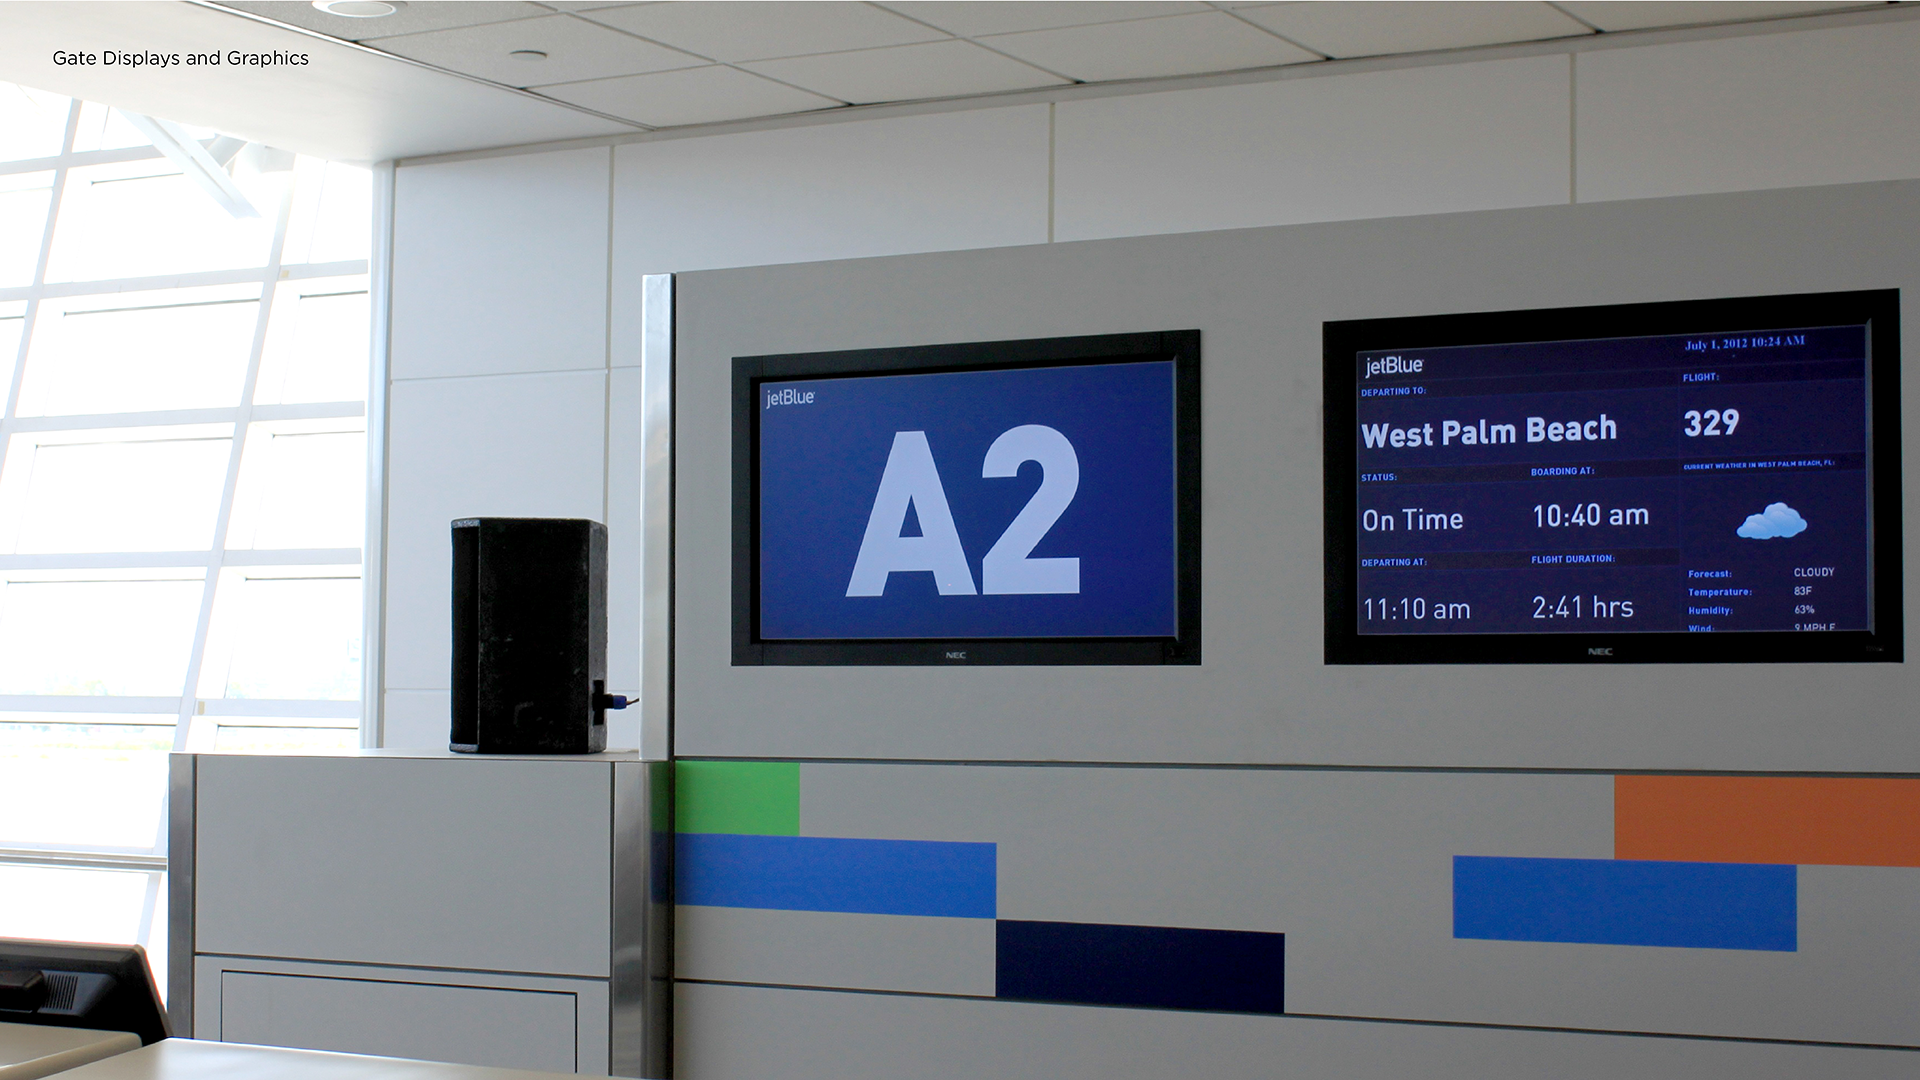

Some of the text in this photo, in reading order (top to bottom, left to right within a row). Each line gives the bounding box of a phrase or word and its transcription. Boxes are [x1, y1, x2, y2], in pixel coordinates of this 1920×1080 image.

[1685, 335, 1806, 353] July 1, 2012 10:24 AM
[1365, 356, 1424, 379] jetBlue
[1683, 373, 1720, 382] FLIGHT:
[1361, 386, 1427, 397] DEPARTING TO:
[766, 388, 815, 410] jetBlue
[1684, 408, 1740, 437] 329
[1361, 414, 1617, 449] West Palm Beach
[1531, 466, 1595, 476] BOARDING AT:
[1361, 473, 1397, 481] STATUS:
[845, 424, 1080, 597] A2
[1533, 503, 1649, 528] 10:40 am
[1362, 508, 1464, 531] On Time
[1361, 557, 1428, 567] DEPARTING AT:
[1531, 554, 1616, 564] FLIGHT DURATION:
[1688, 569, 1732, 578] Forecast:
[1794, 567, 1835, 577] CLOUDY
[1688, 588, 1752, 598] Temperature:
[1794, 586, 1812, 596] 83F
[1363, 598, 1471, 620] 11:10 am
[1532, 595, 1634, 619] 2:41 hrs
[1688, 606, 1733, 615] Humidity:
[1794, 604, 1815, 614] 63%
[946, 651, 967, 659] NEC
[1588, 648, 1613, 656] NEC
